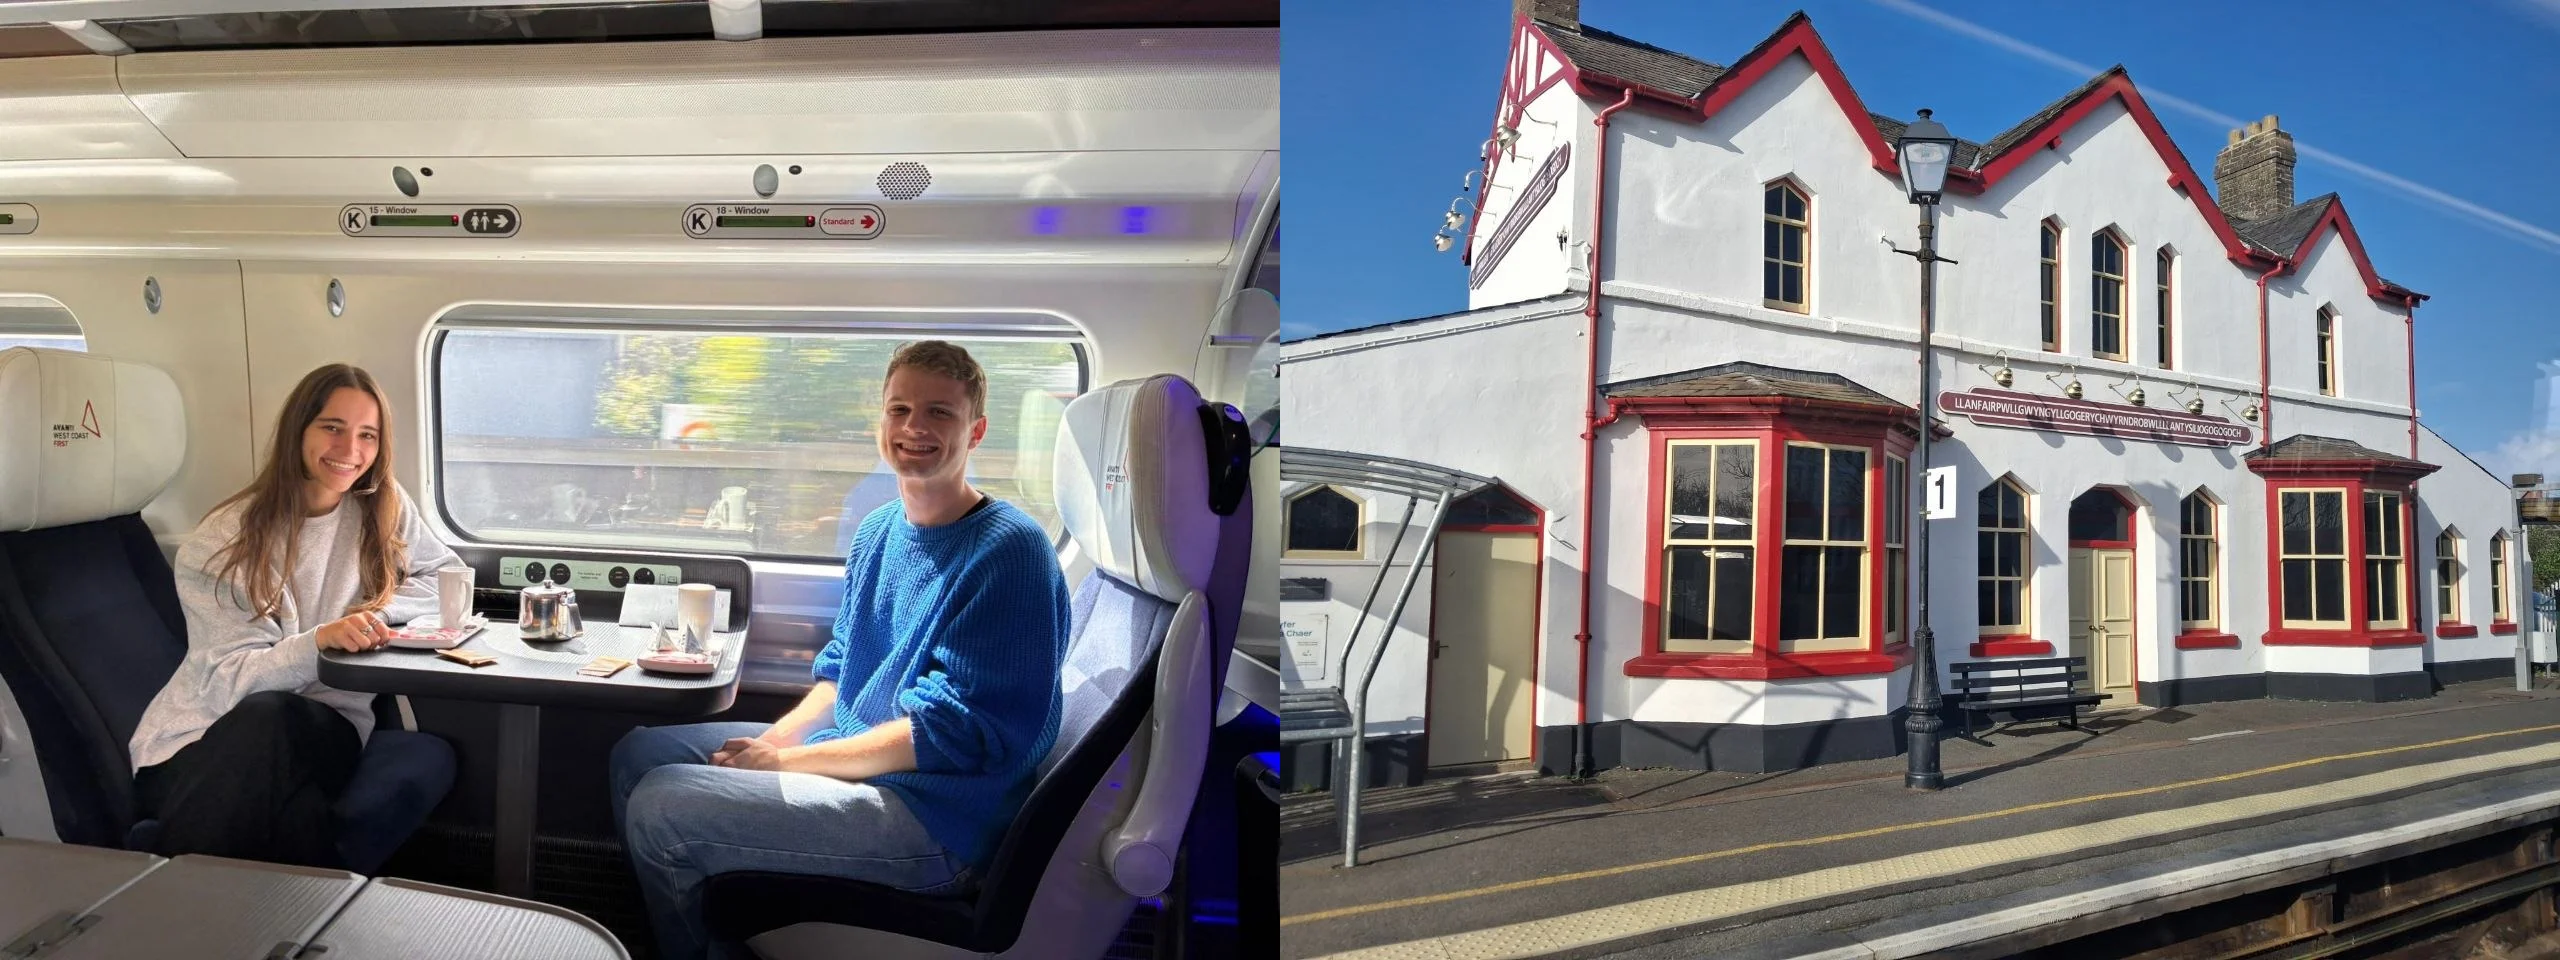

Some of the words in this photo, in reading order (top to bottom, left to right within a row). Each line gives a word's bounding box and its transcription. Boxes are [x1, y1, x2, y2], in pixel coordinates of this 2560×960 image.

[369, 206, 379, 214] 15
[385, 206, 418, 214] Window
[716, 207, 727, 215] 18
[734, 207, 770, 215] Window
[347, 212, 362, 229] K
[692, 213, 706, 230] K
[823, 218, 855, 226] Standard
[1934, 474, 1945, 510] 1
